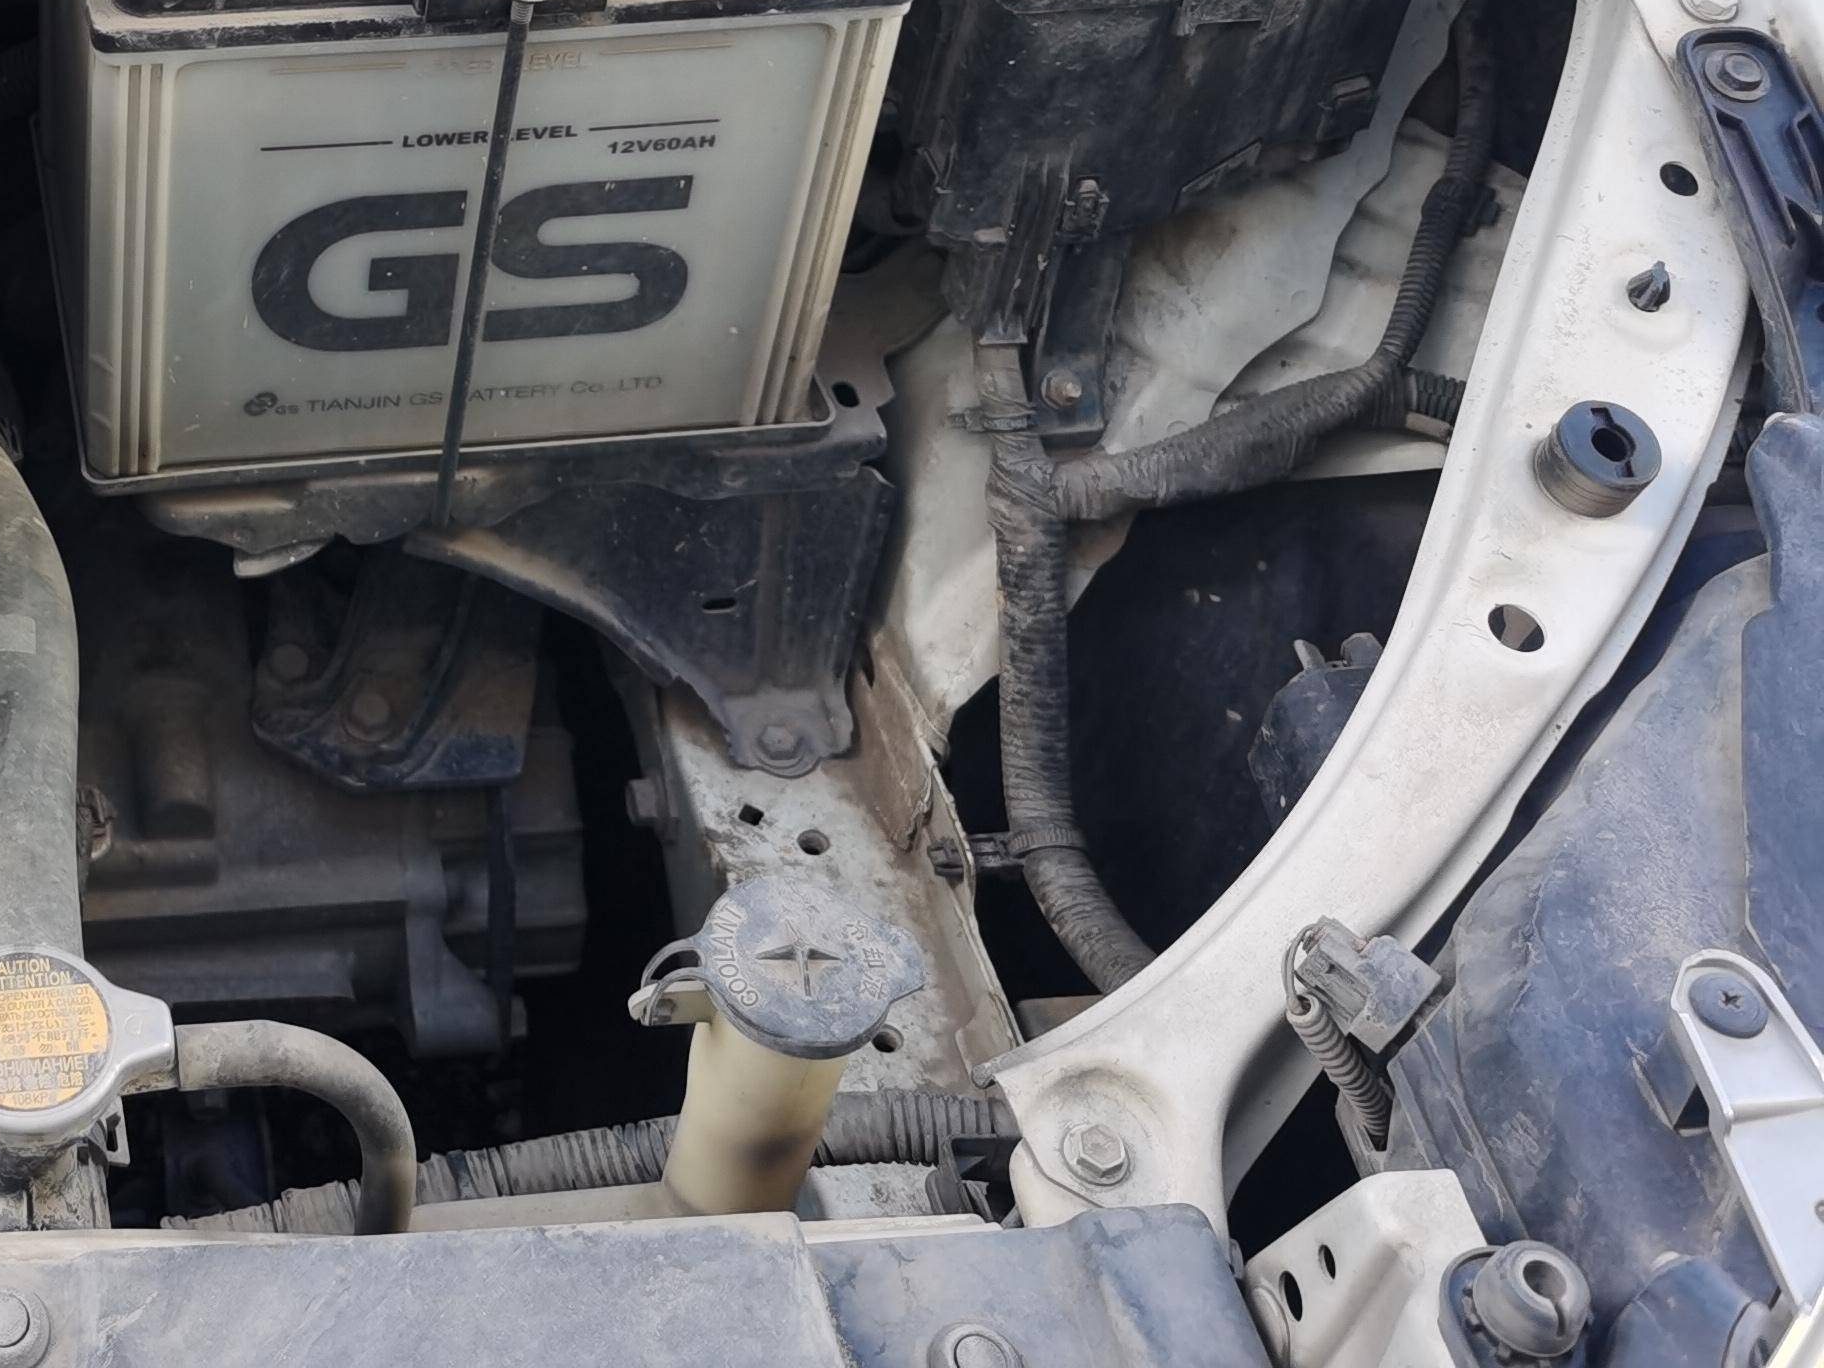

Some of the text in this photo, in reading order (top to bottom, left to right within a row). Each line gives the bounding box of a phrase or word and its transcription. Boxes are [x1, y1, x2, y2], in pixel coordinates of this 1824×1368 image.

[521, 51, 592, 72] EVEL
[402, 124, 578, 149] LOWER EVEL
[607, 134, 716, 155] 12V60AH
[251, 174, 694, 352] GS
[306, 395, 401, 413] TIANJIN
[409, 391, 443, 407] GS
[468, 383, 562, 402] ATTERY
[711, 900, 759, 1007] COOLANT
